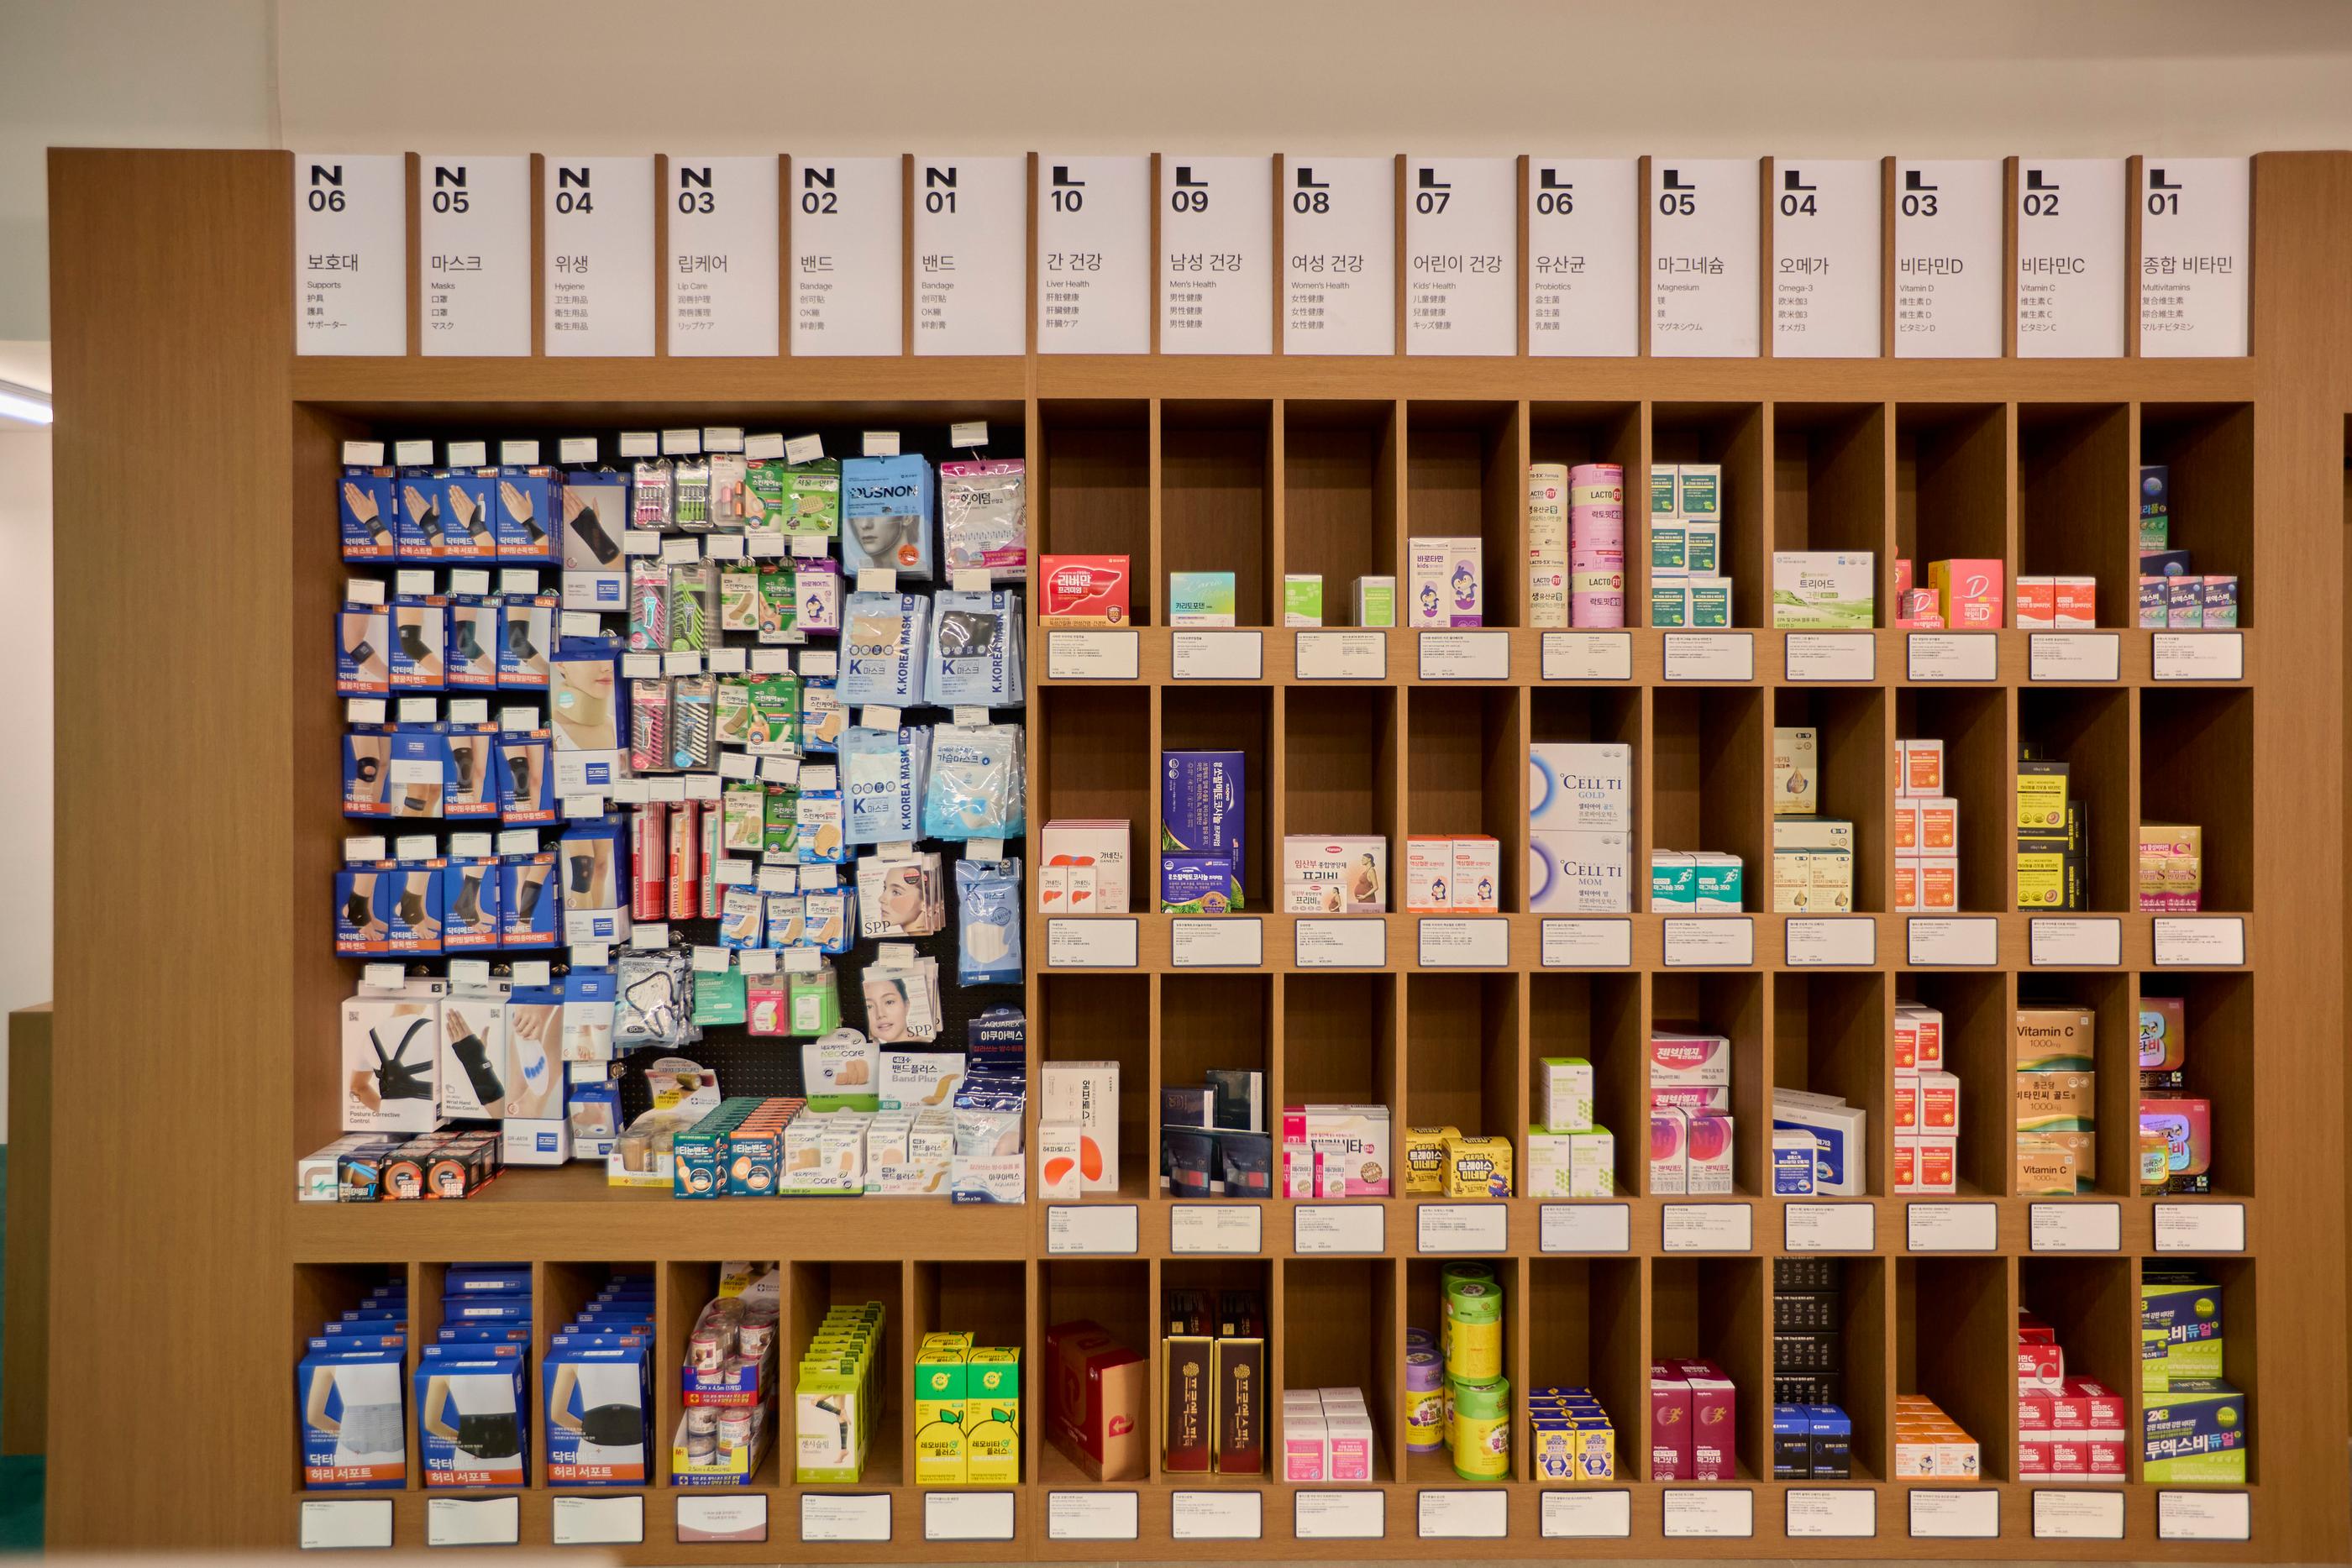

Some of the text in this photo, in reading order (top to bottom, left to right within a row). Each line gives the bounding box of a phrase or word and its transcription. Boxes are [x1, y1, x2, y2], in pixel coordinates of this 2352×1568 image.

[310, 165, 343, 186] N
[435, 166, 466, 187] N
[559, 167, 590, 188] N
[681, 167, 712, 188] N
[805, 167, 835, 188] N
[927, 167, 957, 188] N
[1053, 165, 1085, 186] L
[1176, 166, 1209, 187] L
[1297, 168, 1330, 188] L
[1419, 168, 1452, 189] L
[1540, 169, 1572, 190] L
[1663, 170, 1695, 190] L
[1784, 170, 1817, 191] L
[1905, 170, 1938, 191] L
[2027, 170, 2060, 191] L
[2150, 170, 2182, 190] L
[308, 190, 346, 212] 06
[432, 191, 470, 213] 05
[555, 191, 594, 214] 04
[678, 191, 715, 214] 03
[801, 191, 837, 214] 02
[926, 191, 956, 213] 01
[1051, 190, 1083, 212] 10
[1172, 191, 1208, 212] 09
[1293, 191, 1330, 214] 08
[1416, 192, 1451, 215] 07
[1536, 192, 1573, 215] 06
[1659, 193, 1695, 216] 05
[1780, 194, 1818, 217] 04
[1902, 194, 1939, 217] 03
[2024, 194, 2060, 217] 02
[2148, 193, 2178, 216] 01
[307, 254, 358, 272] 보호대
[431, 254, 482, 273] 마스크
[554, 255, 588, 275] 위생
[678, 255, 727, 274] 립케어
[801, 255, 834, 273] 밴드
[922, 254, 956, 272] 밴드
[1047, 253, 1102, 271] 간 건강
[1171, 253, 1242, 272] 남성 건강
[1292, 254, 1364, 274] 여성 건강
[1413, 255, 1503, 274] 어린이 건강
[1536, 255, 1586, 274] 유산균
[1657, 256, 1725, 275] 마그네슘
[1779, 256, 1830, 275] 오메가
[1900, 257, 1963, 275] 비타민D
[2022, 256, 2086, 275] 비타민C
[2143, 255, 2232, 275] 종합 비타민
[307, 281, 341, 291] Supports
[554, 283, 585, 292] Hygiene
[678, 282, 707, 291] Lip Care
[800, 282, 832, 291] Bandage
[921, 281, 954, 291] Bandage
[1047, 280, 1089, 288] Liver Health
[1169, 281, 1216, 289] Men's Health
[1291, 281, 1349, 290] Women's Health
[1413, 281, 1457, 291] Kids' Health
[1536, 282, 1571, 291] Probiotics
[1657, 284, 1699, 292] Magnesium
[1778, 283, 1814, 293] Omega-3
[1899, 284, 1935, 292] Vitamin D
[2021, 284, 2055, 292] Vitamin C
[2142, 283, 2191, 291] Multivitamins
[554, 296, 588, 305] 卫生用品
[1169, 293, 1202, 302] 男性健康
[1291, 294, 1324, 303] 女性健康
[1413, 295, 1446, 304] 儿童健康
[1925, 297, 1932, 306] D
[2047, 297, 2053, 306] C
[1169, 307, 1202, 316] 男性健康
[1291, 307, 1324, 317] 女性健康
[1169, 319, 1202, 328] 男性健康
[1291, 320, 1324, 330] 女性健康
[1413, 321, 1452, 330] キッズ健康
[1536, 322, 1560, 331] 乳酸菌
[1657, 323, 1704, 332] マグネシウム
[1778, 323, 1806, 333] オメガ3
[1900, 324, 1935, 333] ビタミン D
[2021, 324, 2056, 333] ビタミン C
[2142, 323, 2194, 333] マルチビタミン
[1591, 490, 1612, 500] LACTO
[1417, 554, 1444, 564] 바로타민
[1058, 574, 1092, 587] 리버만
[1589, 578, 1611, 587] LACTO
[1798, 578, 1835, 590] 트리어드
[1175, 601, 1205, 611] 카리토포텐
[897, 615, 912, 695] K.KOREA MASK
[849, 659, 863, 675] K
[864, 667, 885, 675] 마스크
[942, 659, 956, 675] K
[957, 667, 979, 675] 마스크
[1563, 774, 1622, 790] CELL TI
[900, 748, 911, 830] K.KOREA MASK
[853, 799, 866, 814] K
[1100, 851, 1120, 859] 가네진
[1294, 859, 1317, 868] 임산부
[1563, 862, 1622, 877] CELL TI
[1296, 897, 1317, 905] 프리비
[864, 920, 891, 935] SPP
[907, 1024, 932, 1038] SPP
[981, 1030, 1023, 1041] 아쿠아렉스
[2017, 1026, 2074, 1037] Vitamin C
[892, 1064, 938, 1074] 밴드플러스
[892, 1074, 937, 1083] Band Plus
[2033, 1081, 2055, 1089] 종근당
[2053, 1091, 2071, 1100] 골드
[1410, 1151, 1442, 1161] 트레이스
[1458, 1161, 1493, 1171] 트레이스
[2023, 1166, 2067, 1174] Vitamin C
[882, 1172, 917, 1181] 밴드플러스
[989, 1172, 1021, 1182] 아쿠아렉스
[1462, 1171, 1488, 1181] 미네랄
[2035, 1362, 2056, 1385] C
[921, 1440, 949, 1450] 레모비타
[972, 1439, 1000, 1449] 레모비타
[2145, 1430, 2234, 1459] 투엑스비듀얼
[935, 1448, 956, 1456] 플러스
[986, 1447, 1008, 1455] 플러스
[311, 1466, 373, 1480] 허리 서포트
[432, 1470, 492, 1483] 허리 서포트
[554, 1466, 613, 1478] 허리 서포트
